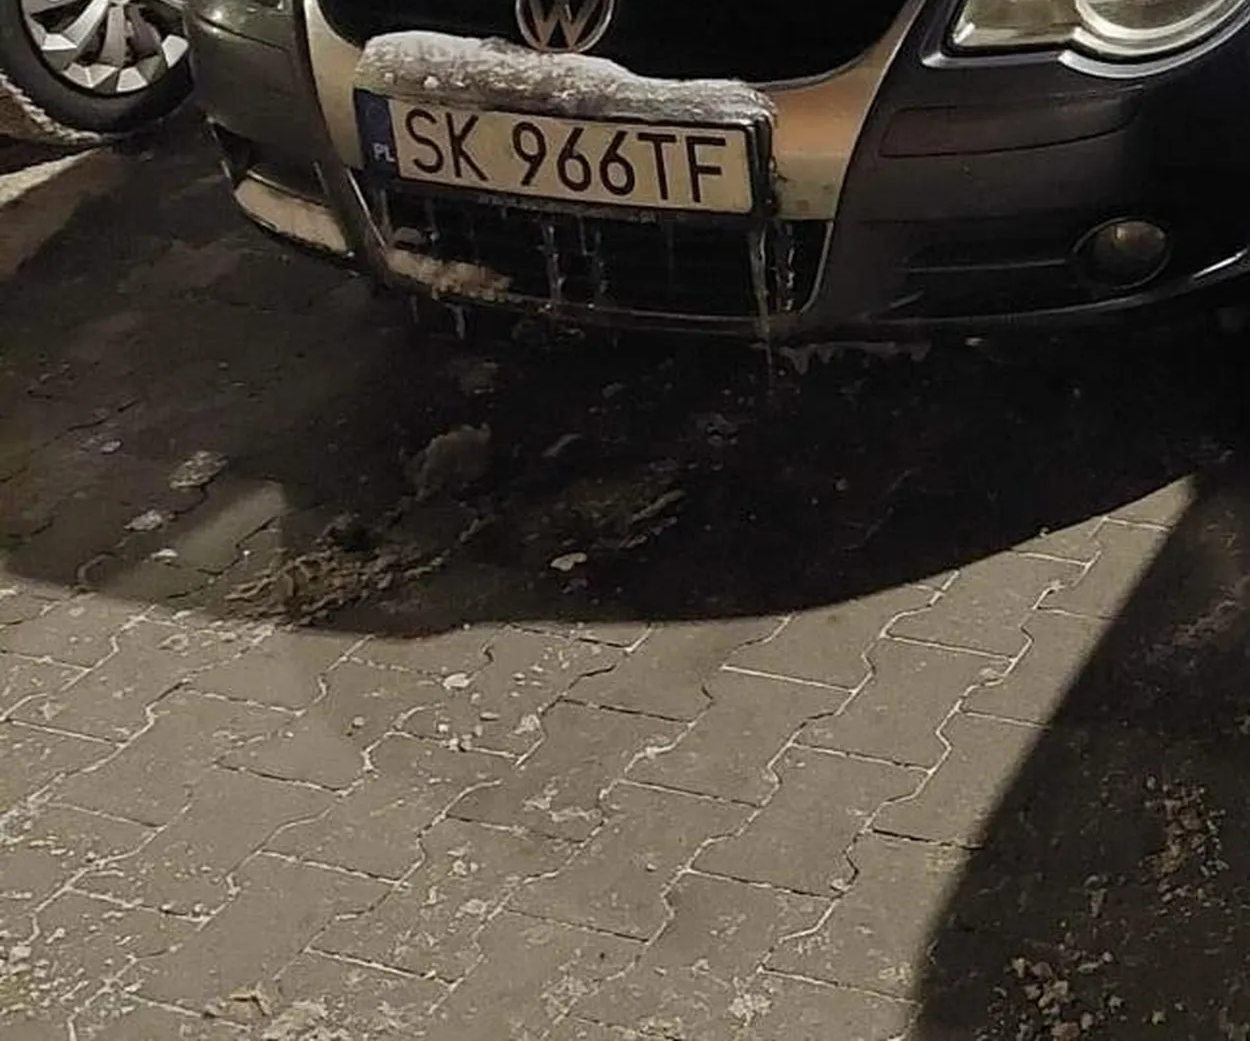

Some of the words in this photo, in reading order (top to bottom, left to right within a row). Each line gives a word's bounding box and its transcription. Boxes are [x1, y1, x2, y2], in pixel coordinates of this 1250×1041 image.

[372, 142, 396, 163] PL
[405, 108, 489, 181] SK
[511, 121, 727, 203] 966TF
